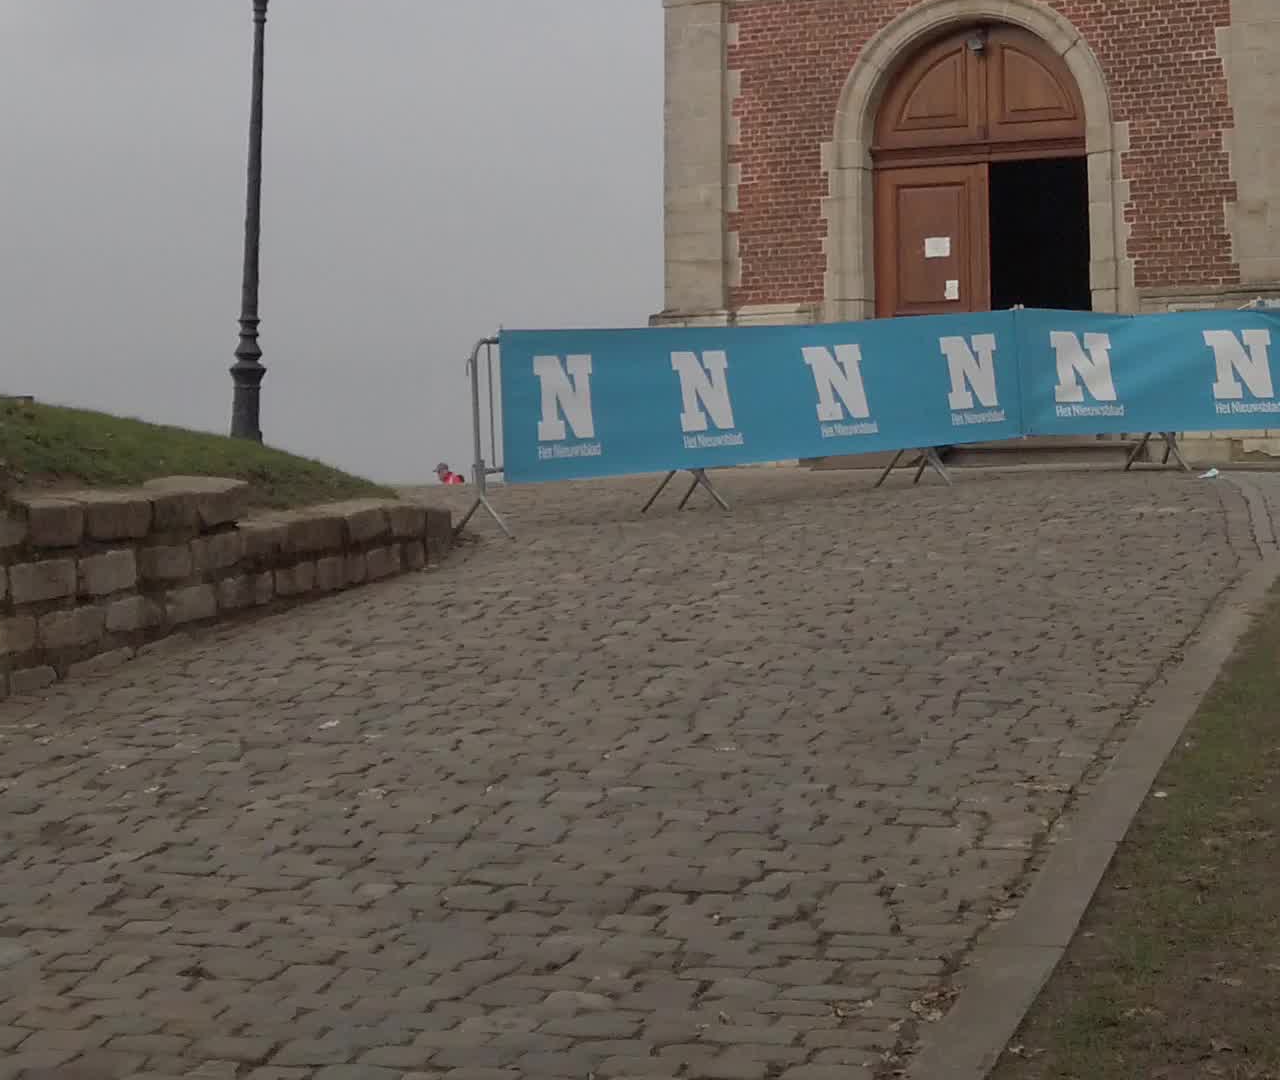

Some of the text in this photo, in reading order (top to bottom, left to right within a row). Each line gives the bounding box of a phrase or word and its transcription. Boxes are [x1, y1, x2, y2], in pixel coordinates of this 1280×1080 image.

[533, 354, 595, 441] N
[671, 350, 735, 432] N
[801, 344, 869, 421] N
[939, 333, 997, 410] N
[1050, 331, 1117, 402] N
[1202, 329, 1274, 399] N
[1055, 404, 1071, 417] Het
